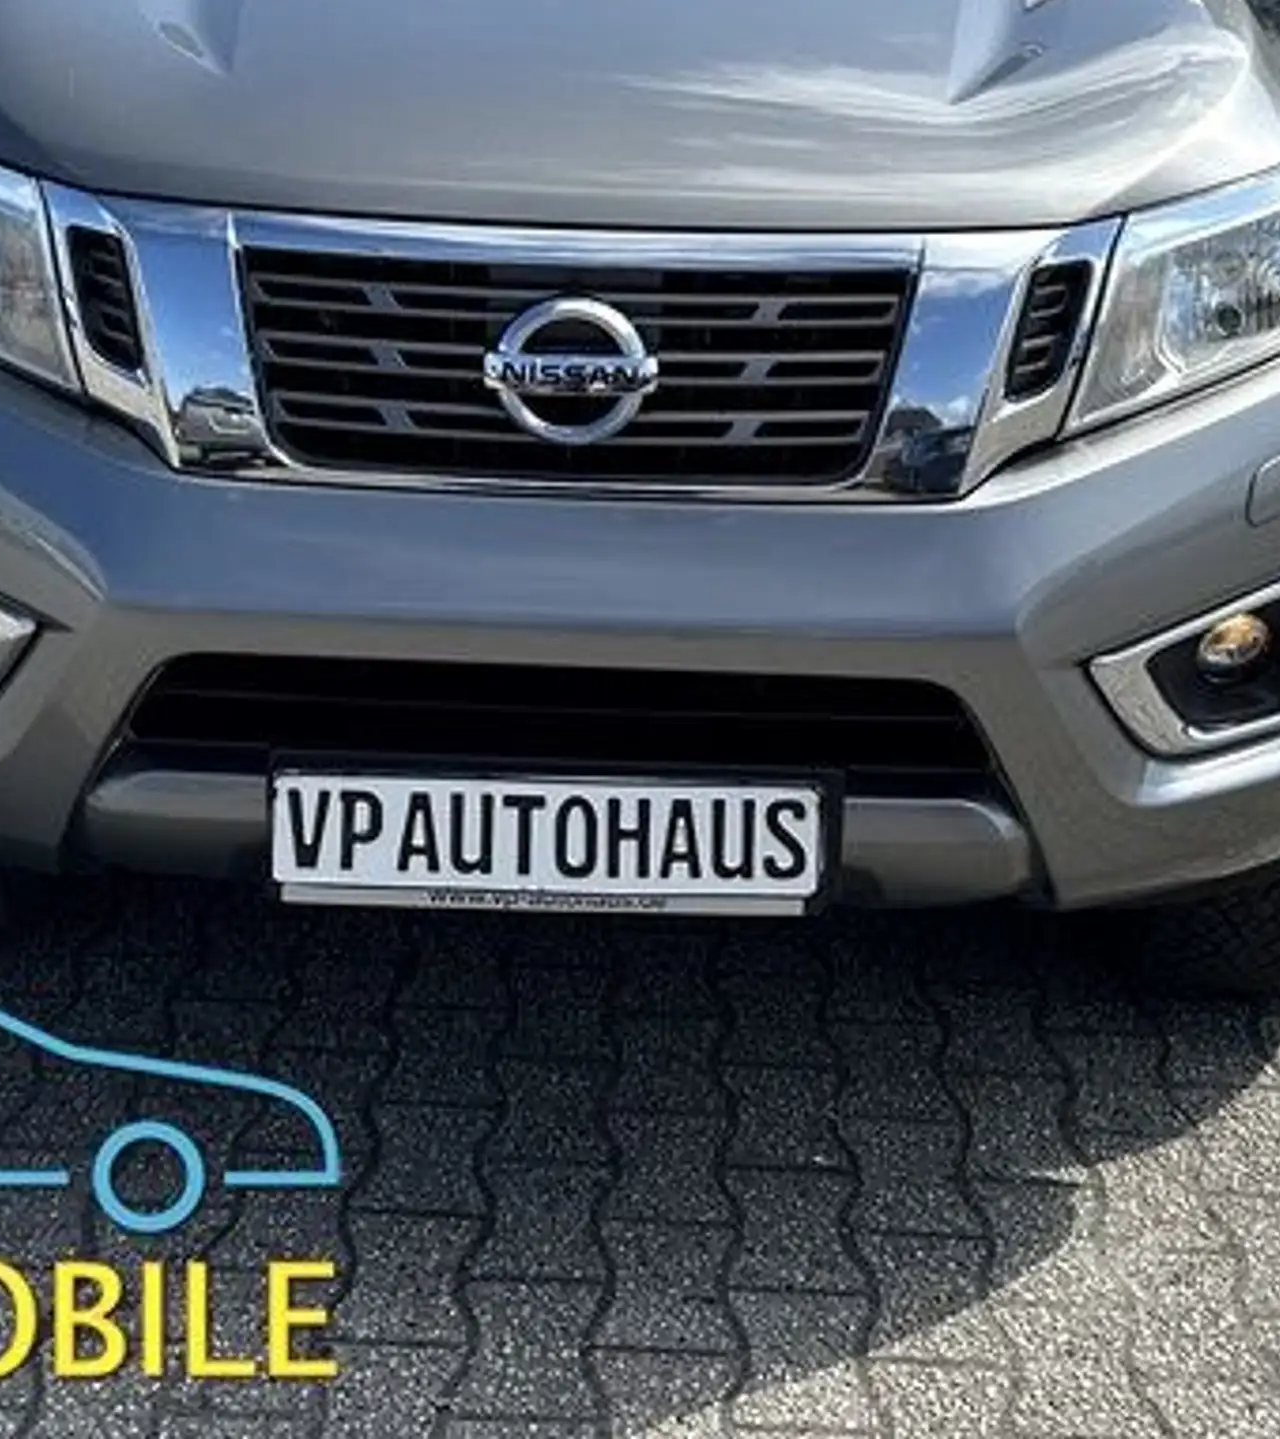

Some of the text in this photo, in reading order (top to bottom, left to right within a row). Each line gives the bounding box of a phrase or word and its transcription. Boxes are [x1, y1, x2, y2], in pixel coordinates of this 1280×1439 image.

[501, 361, 641, 386] NISSAN
[287, 787, 807, 880] VP AUTOHAUS
